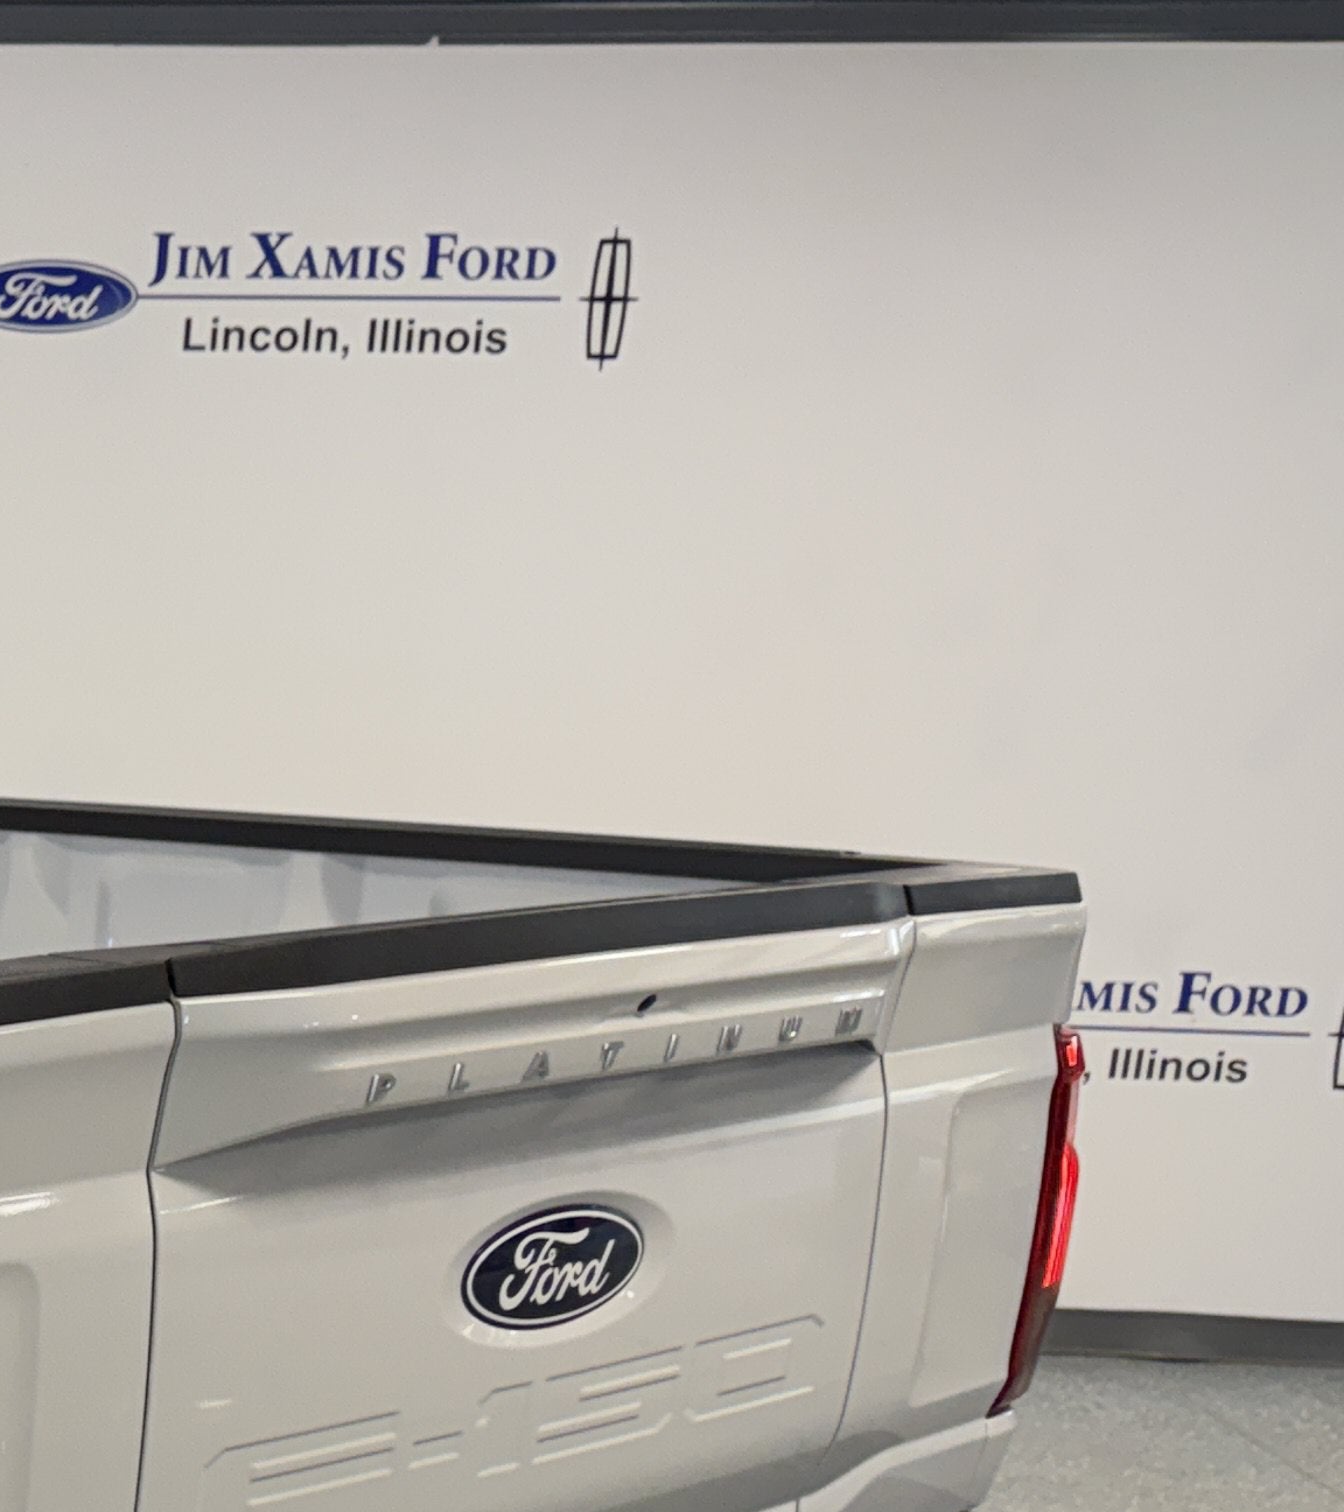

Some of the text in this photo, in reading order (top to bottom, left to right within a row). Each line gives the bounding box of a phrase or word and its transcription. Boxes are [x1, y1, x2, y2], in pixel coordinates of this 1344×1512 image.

[148, 232, 557, 287] JIM XAMIS FORD
[182, 317, 508, 360] Lincoln, Illinois
[1075, 971, 1309, 1019] MIS FORD
[366, 1006, 864, 1106] PLATINUM
[1108, 1048, 1249, 1084] Illinois
[498, 1227, 615, 1311] Ford
